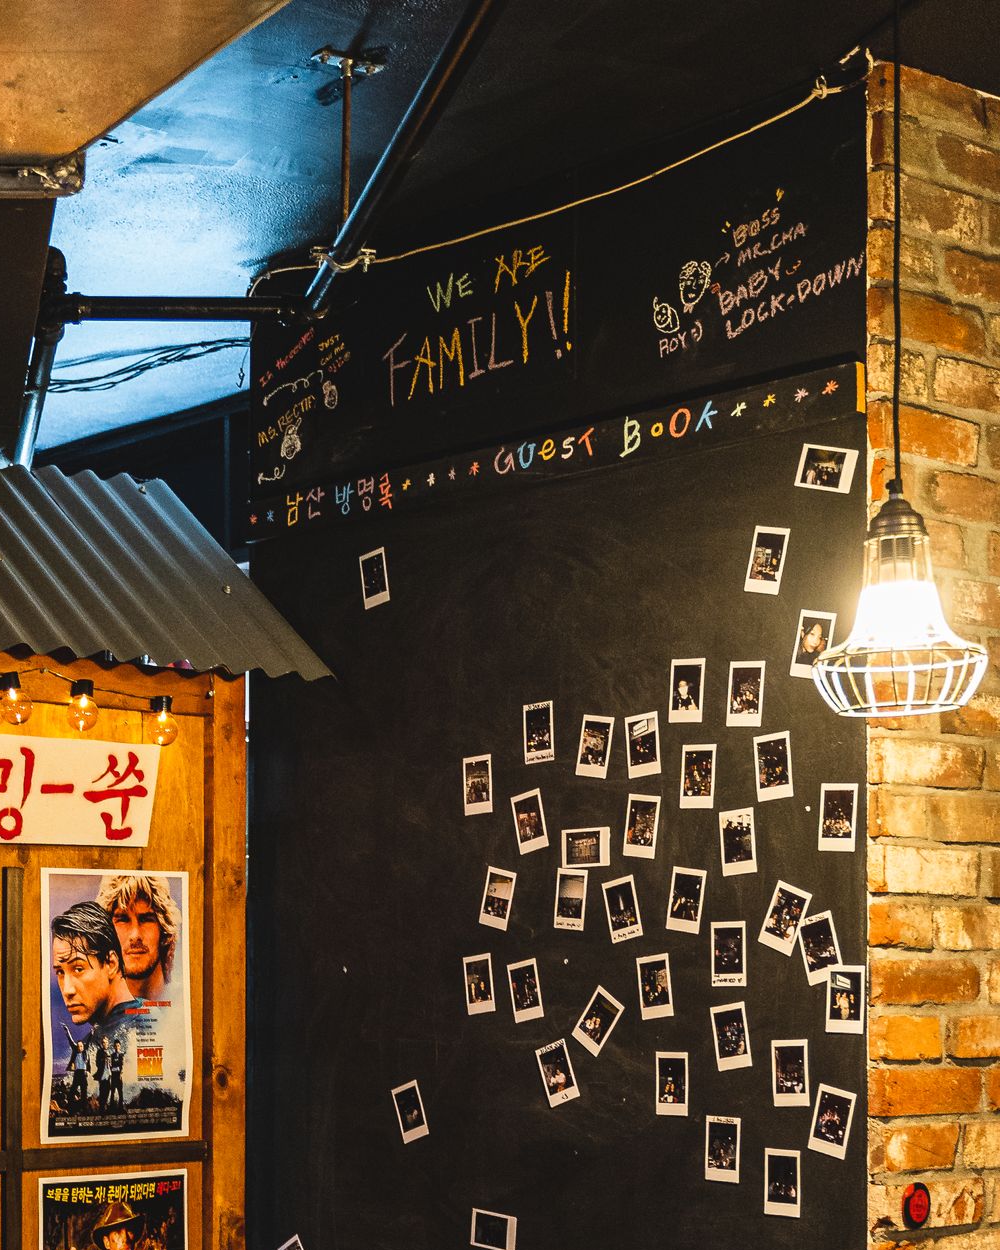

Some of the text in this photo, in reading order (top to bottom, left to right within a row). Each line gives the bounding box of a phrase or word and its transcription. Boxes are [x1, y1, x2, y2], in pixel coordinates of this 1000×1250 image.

[427, 245, 551, 313] WE ARE
[719, 257, 782, 316] BABY
[382, 269, 571, 407] FAMILY!!
[286, 472, 393, 527] 남산 방명록
[136, 1047, 163, 1058] POINT
[46, 1187, 70, 1202] 보물을
[71, 1187, 94, 1203] 탐하는
[95, 1185, 106, 1204] 자!
[107, 1184, 129, 1203] 준비가
[130, 1182, 156, 1201] 되었다면
